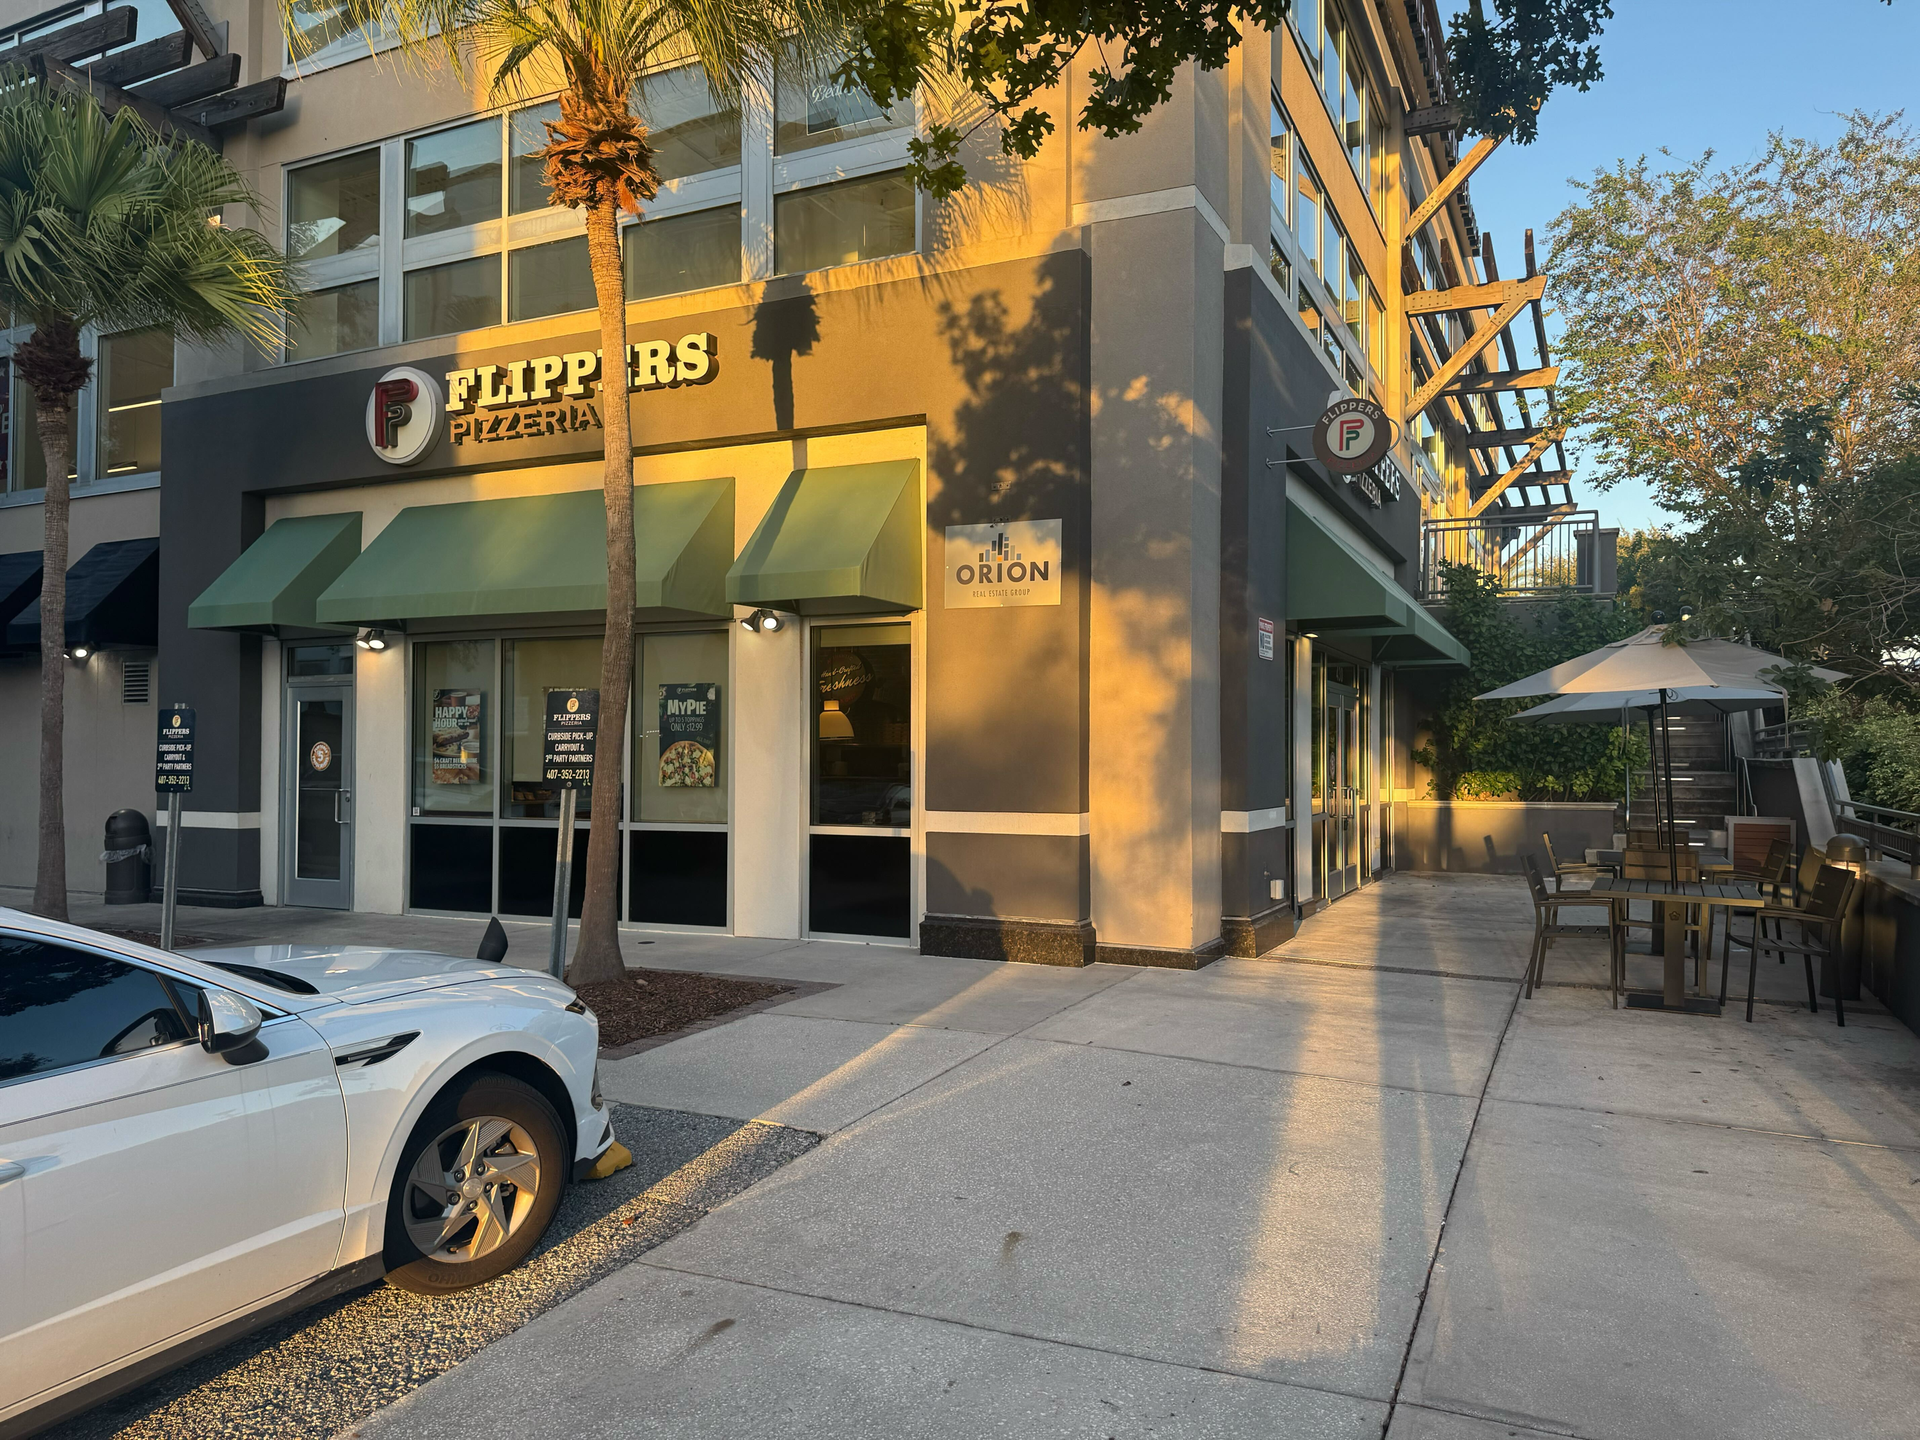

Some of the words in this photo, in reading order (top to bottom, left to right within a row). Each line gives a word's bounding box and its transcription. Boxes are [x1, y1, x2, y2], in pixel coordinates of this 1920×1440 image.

[1321, 401, 1381, 425] FLIPPERS
[450, 402, 602, 444] PIZZERIA
[956, 561, 1049, 585] ORION
[972, 590, 986, 598] REAL
[988, 589, 1008, 597] ESTATE
[1010, 588, 1031, 596] GROUP
[435, 706, 468, 718] HAPPY
[553, 713, 591, 721] FLIPPERS
[435, 718, 458, 728] HOUR
[670, 723, 686, 732] ONLY
[686, 722, 703, 732] $12.99
[547, 732, 572, 740] CURBSIDE
[159, 744, 176, 752] CURBSIDE
[555, 743, 580, 751] CARRYOUT
[580, 743, 585, 751] &
[164, 753, 182, 761] CARRYOUT
[317, 750, 324, 762] 5
[553, 754, 568, 763] PARTY
[568, 754, 593, 763] PARTNERS
[546, 769, 590, 780] 407-352-2213
[158, 775, 190, 785] 407-352-2213
